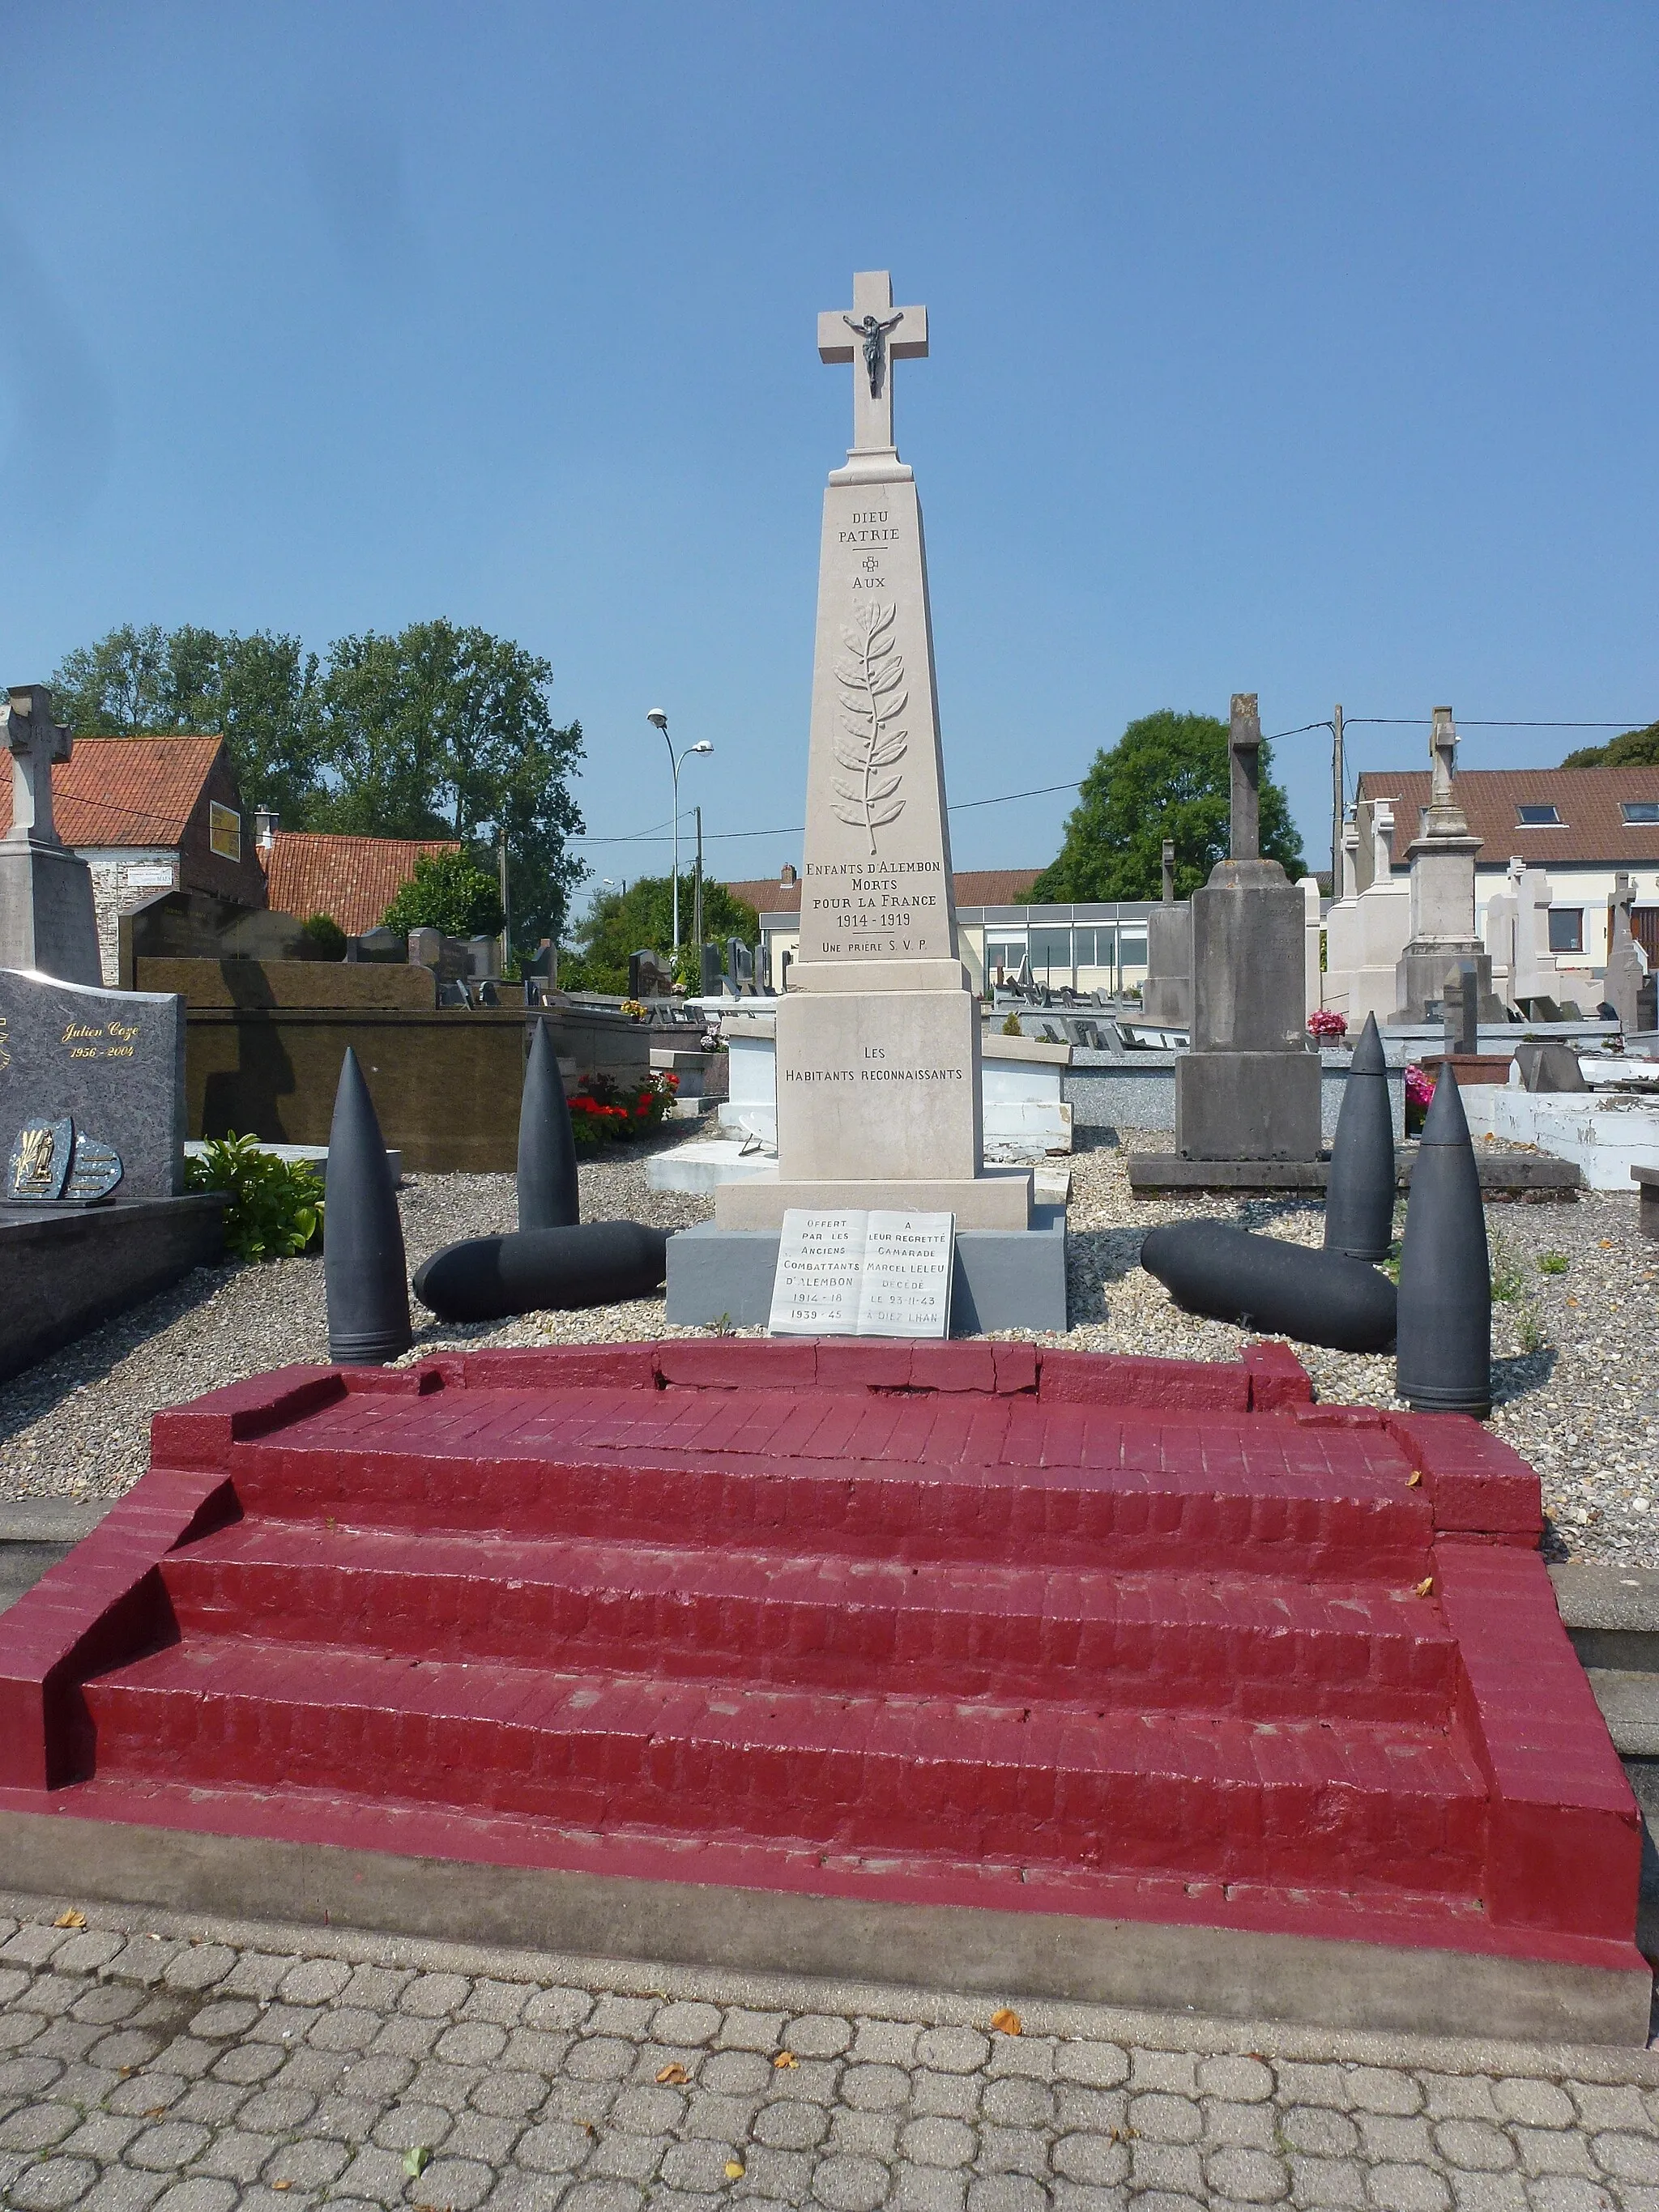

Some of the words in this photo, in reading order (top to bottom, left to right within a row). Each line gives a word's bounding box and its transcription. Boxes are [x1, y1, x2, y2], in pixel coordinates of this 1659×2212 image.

[852, 511, 889, 524] DIEU
[838, 529, 899, 543] PATRIE
[852, 577, 885, 589] AUX
[806, 863, 864, 875] ENFANTS
[868, 861, 940, 873] D'ALEMBON
[851, 879, 898, 891] MORTS
[812, 898, 851, 910] POUR
[858, 897, 876, 907] LA
[881, 895, 936, 907] FRANCE
[837, 914, 868, 927] 1914
[881, 913, 911, 926] 1919
[822, 942, 841, 953] UNE
[61, 1022, 103, 1043] Julien
[70, 1047, 97, 1058] 1956
[107, 1046, 134, 1057] 2004
[864, 1046, 885, 1059] LES
[786, 1070, 855, 1081] HABITANTS
[861, 1069, 962, 1080] RECONNAISSANTS
[807, 1220, 847, 1228] OFFERT
[905, 1221, 911, 1230] A
[868, 1233, 892, 1241] LEUR
[896, 1233, 945, 1243] REGRETTÉ
[801, 1247, 846, 1255] ANCIENS
[878, 1247, 936, 1257] CAMARADE
[783, 1260, 859, 1271] COMBATTANTS
[867, 1263, 906, 1272] MARCEL
[911, 1264, 945, 1273] LELEU
[793, 1294, 818, 1302] 1914
[831, 1294, 842, 1302] 18
[791, 1310, 817, 1319] 1939
[828, 1311, 842, 1319] 45
